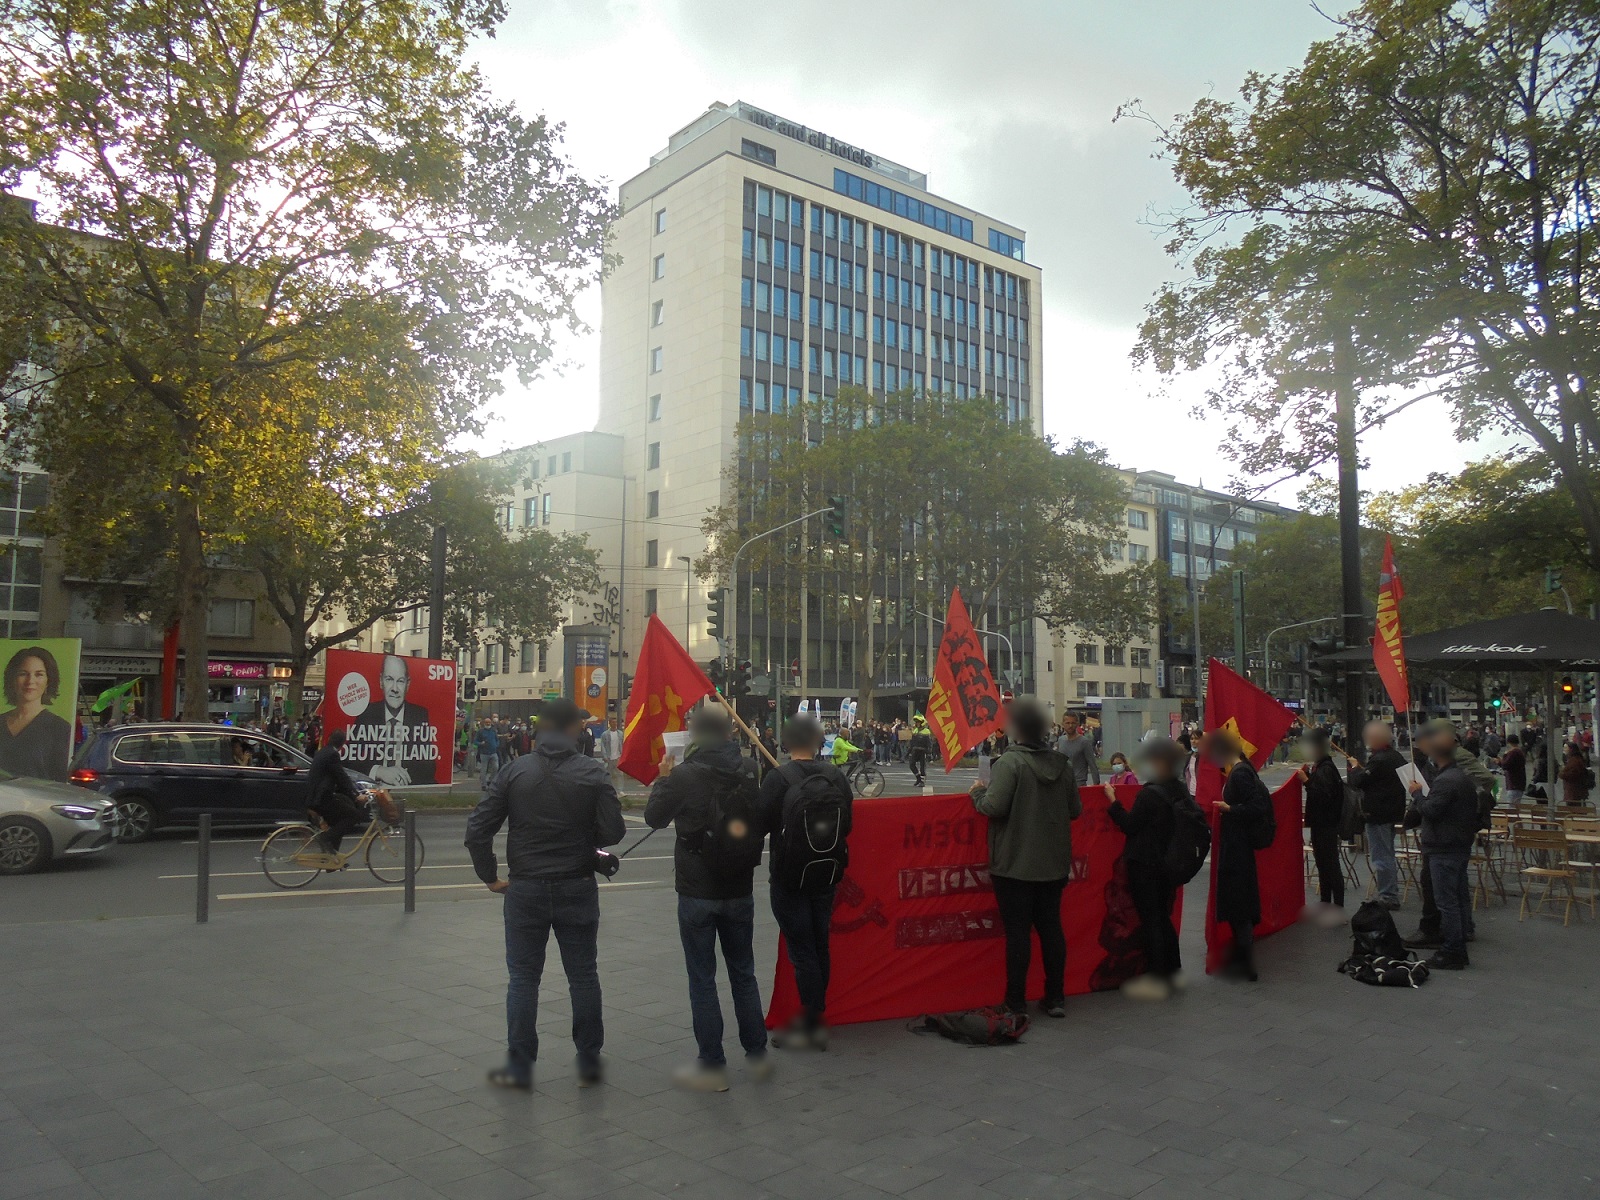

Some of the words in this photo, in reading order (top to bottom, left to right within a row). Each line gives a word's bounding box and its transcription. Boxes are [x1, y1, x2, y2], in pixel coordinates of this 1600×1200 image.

[778, 121, 806, 143] and
[809, 132, 828, 151] all
[829, 137, 873, 168] hotels
[428, 665, 454, 681] SPD
[339, 690, 356, 701] SCHOLZ
[346, 724, 410, 742] KANZLER
[413, 722, 438, 742] FÜR
[339, 744, 442, 761] DEUTSCHLAND.
